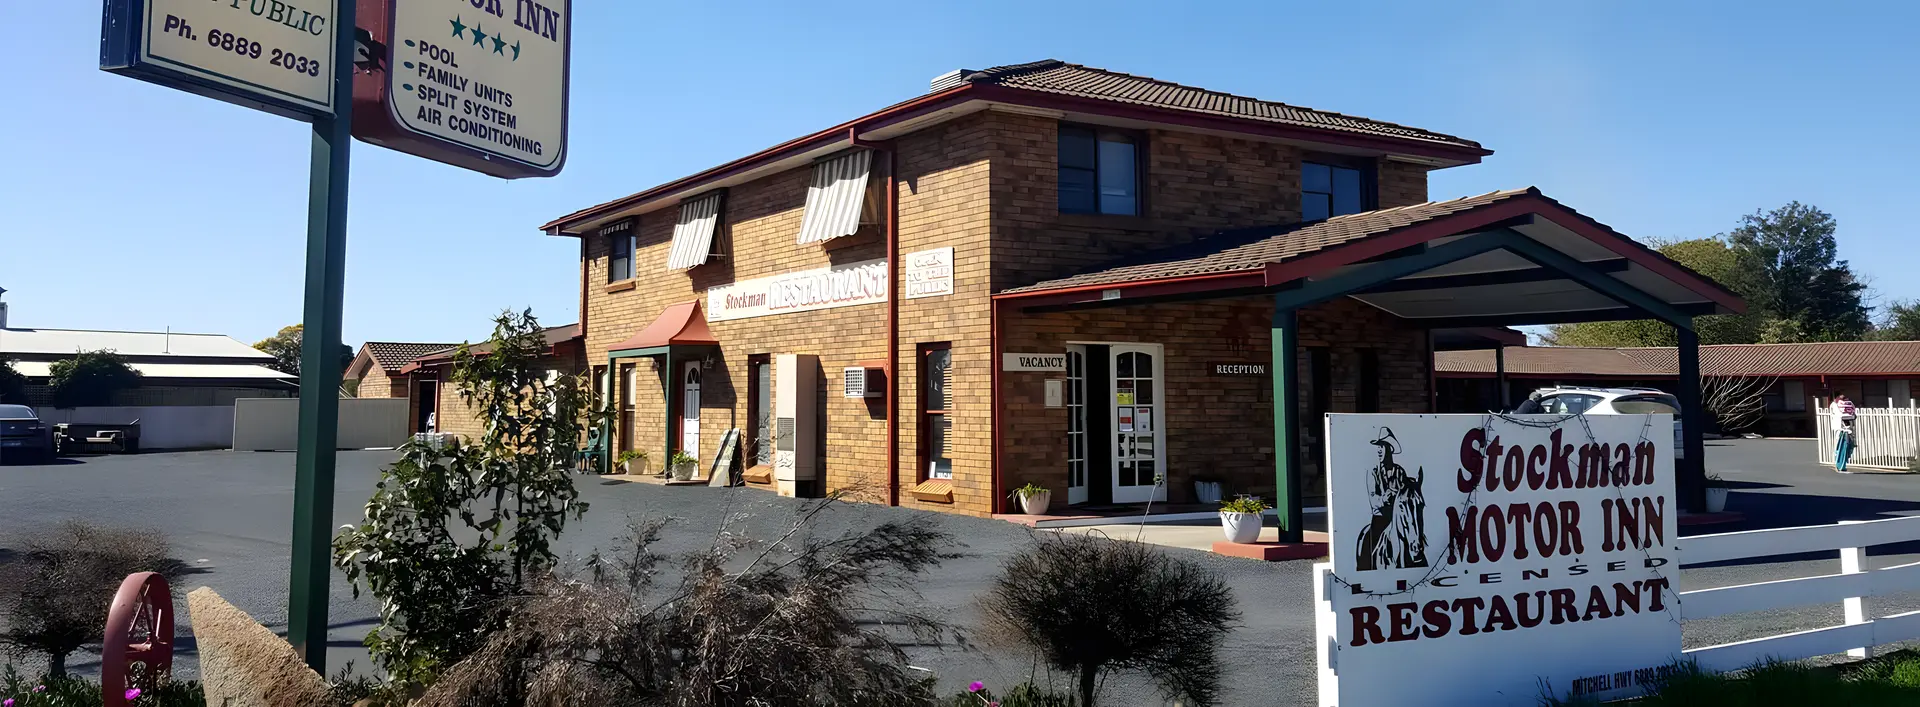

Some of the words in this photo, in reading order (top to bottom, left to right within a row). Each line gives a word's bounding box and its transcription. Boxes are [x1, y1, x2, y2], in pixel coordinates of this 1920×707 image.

[513, 0, 560, 42] INN
[163, 14, 197, 41] Ph.
[207, 29, 262, 59] 6889
[269, 48, 320, 77] 2033
[419, 40, 458, 68] POOL
[417, 84, 457, 110] SPLIT
[463, 99, 517, 129] SYSTEM
[418, 62, 468, 92] FAMILY
[474, 82, 513, 107] UNITS
[417, 105, 442, 126] AIR
[448, 115, 542, 156] CONDITIONING
[725, 292, 767, 310] Stockman
[769, 262, 888, 311] RESTAURANT
[1019, 356, 1064, 368] VACANCY
[1216, 364, 1265, 374] RECEPTION
[1457, 428, 1655, 493] Stockman
[1446, 500, 1584, 565] MOTOR
[1601, 495, 1665, 552] INN
[1351, 557, 1668, 595] LICENSED
[1349, 577, 1670, 647] RESTAURANT
[1572, 674, 1612, 696] MITCHELL
[1614, 670, 1632, 688] HWY
